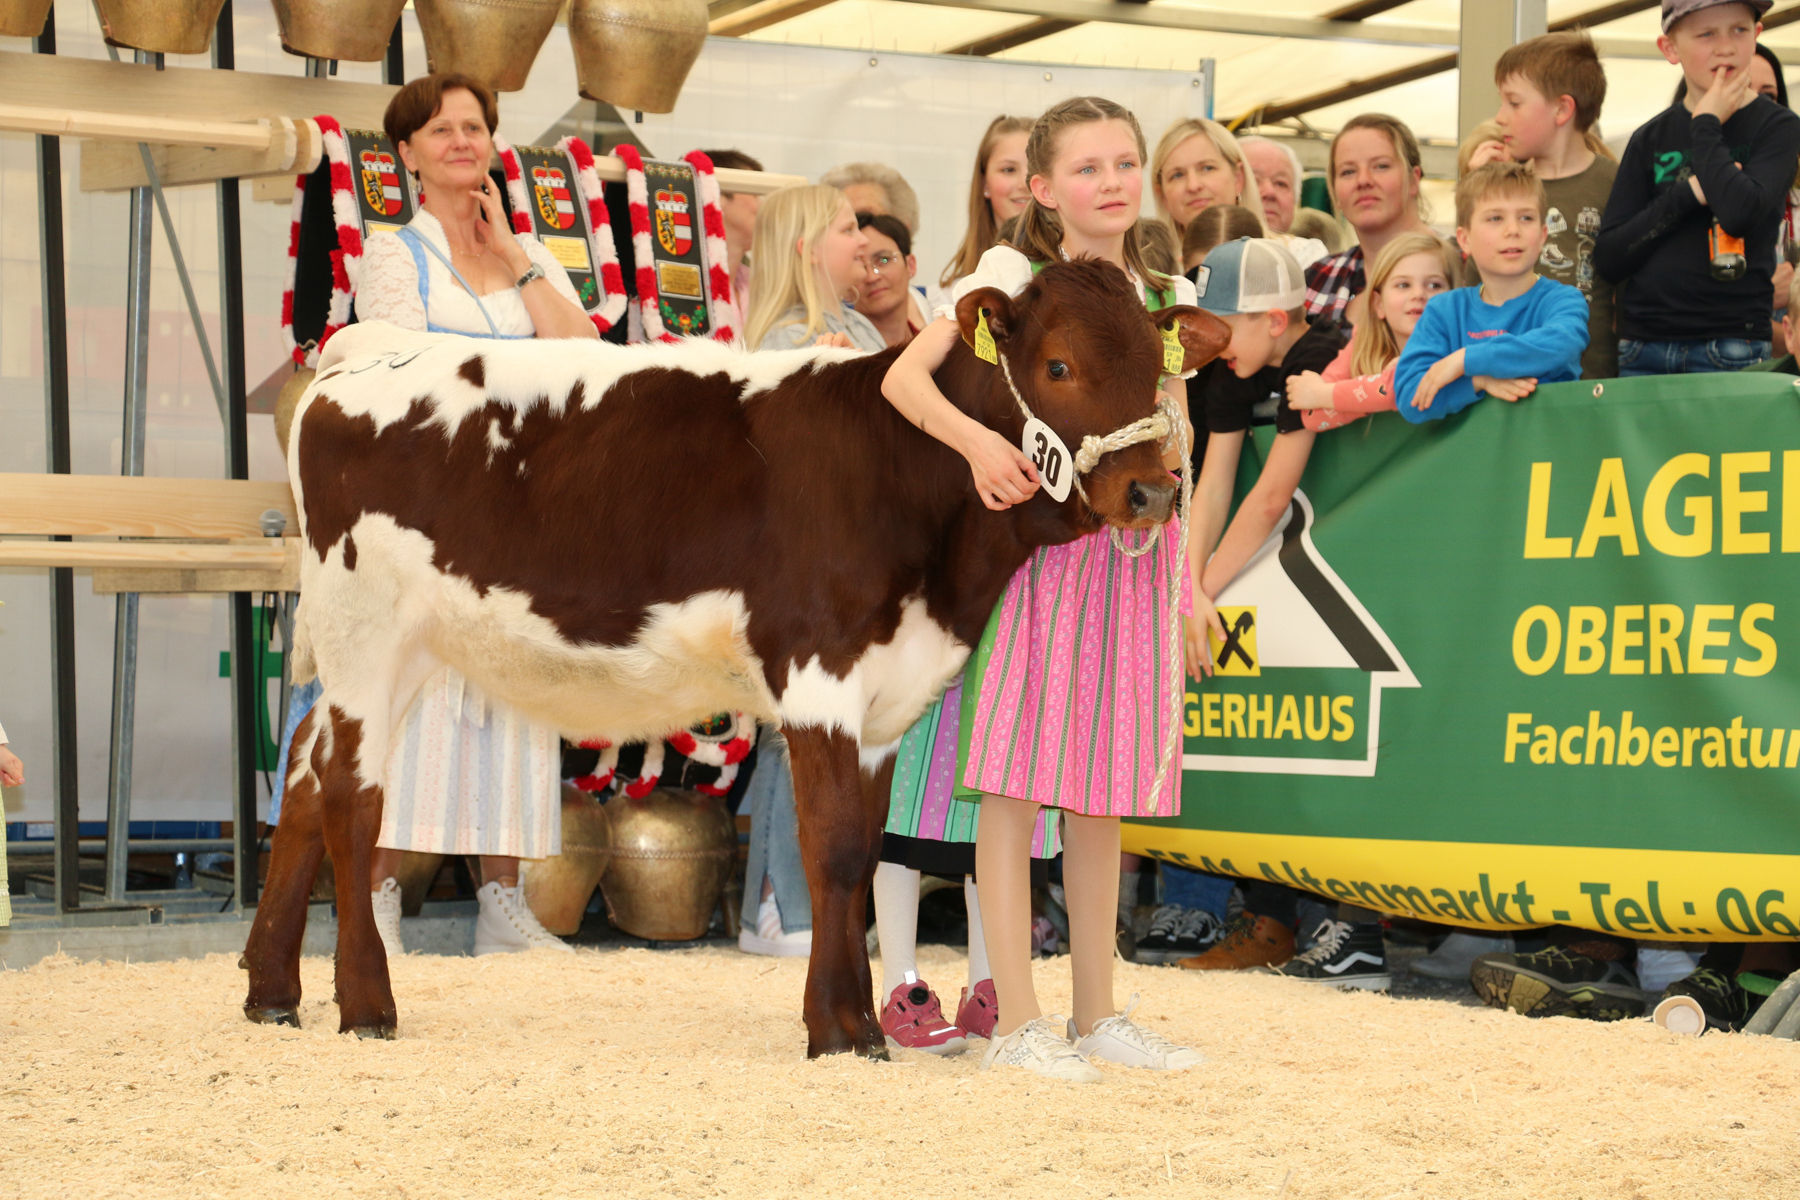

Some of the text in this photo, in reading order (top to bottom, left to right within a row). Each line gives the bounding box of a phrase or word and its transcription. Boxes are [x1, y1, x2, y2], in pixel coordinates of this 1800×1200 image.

[1032, 431, 1062, 488] 30
[1512, 602, 1778, 677] OBERES
[1258, 861, 1538, 925] Altenmarkt
[1580, 880, 1713, 934] Tel.:
[1716, 887, 1800, 937] 06
